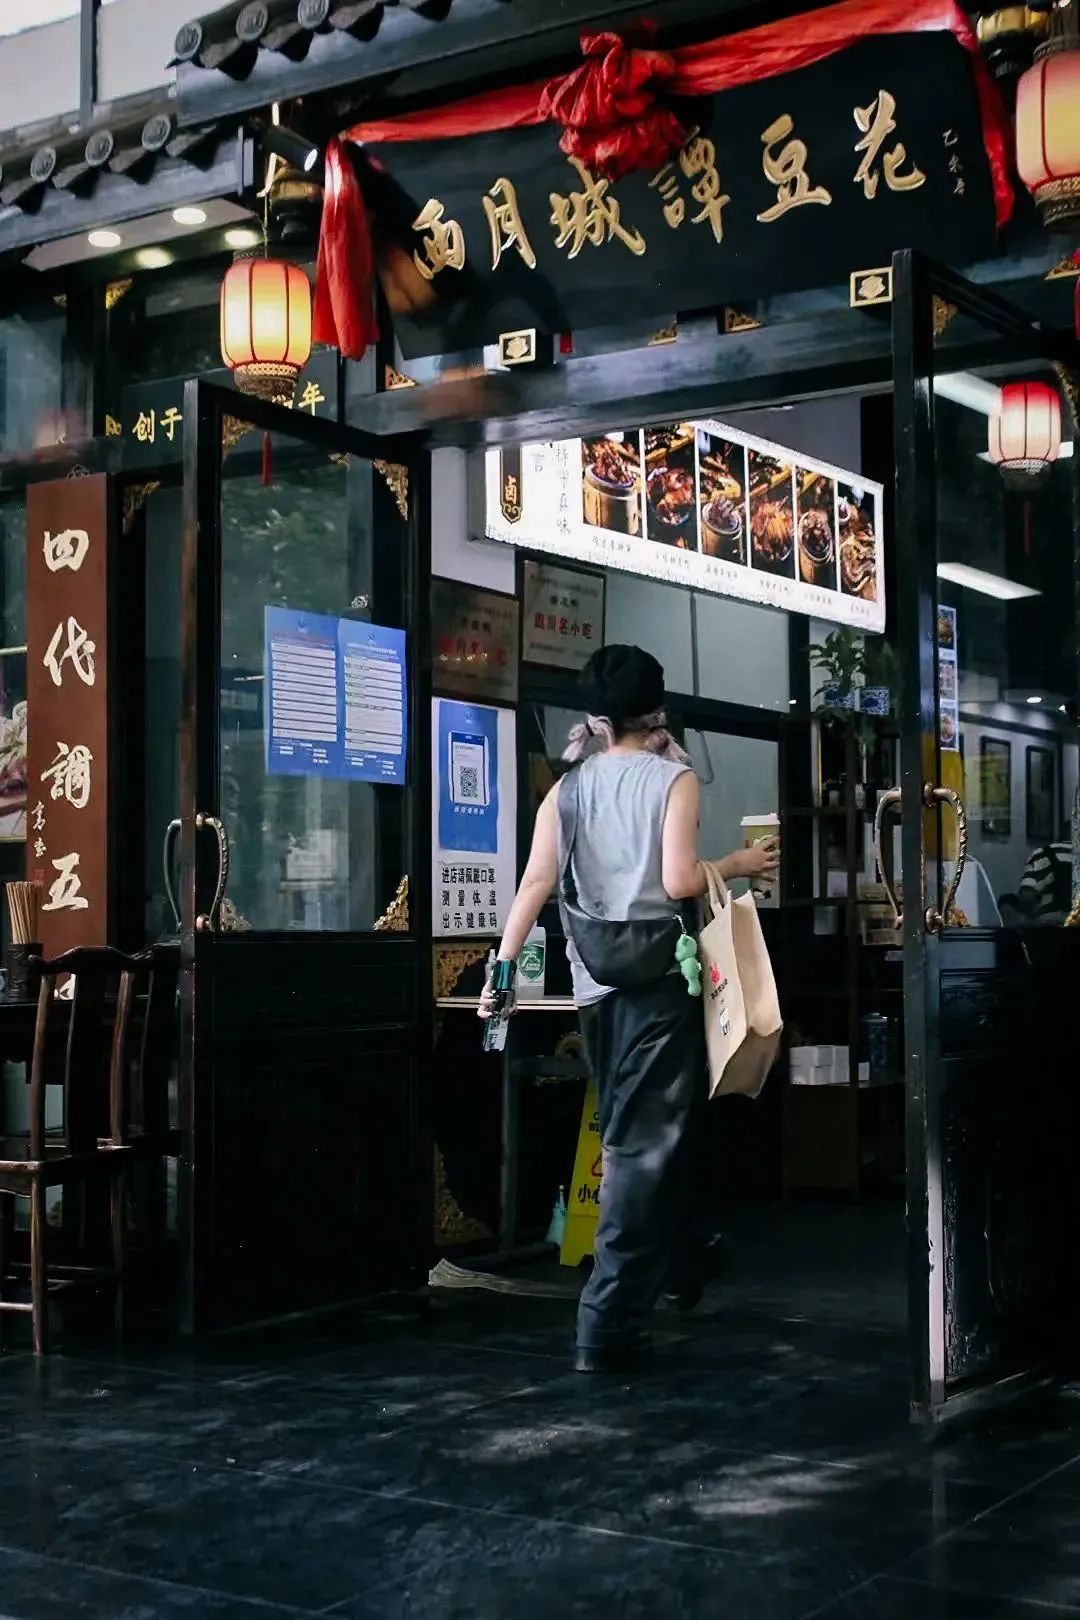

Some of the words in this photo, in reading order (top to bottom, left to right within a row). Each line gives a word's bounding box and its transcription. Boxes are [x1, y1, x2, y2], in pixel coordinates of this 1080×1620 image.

[131, 406, 184, 444] 创于
[441, 889, 497, 907] 测量体温
[441, 911, 498, 929] 出示健康码
